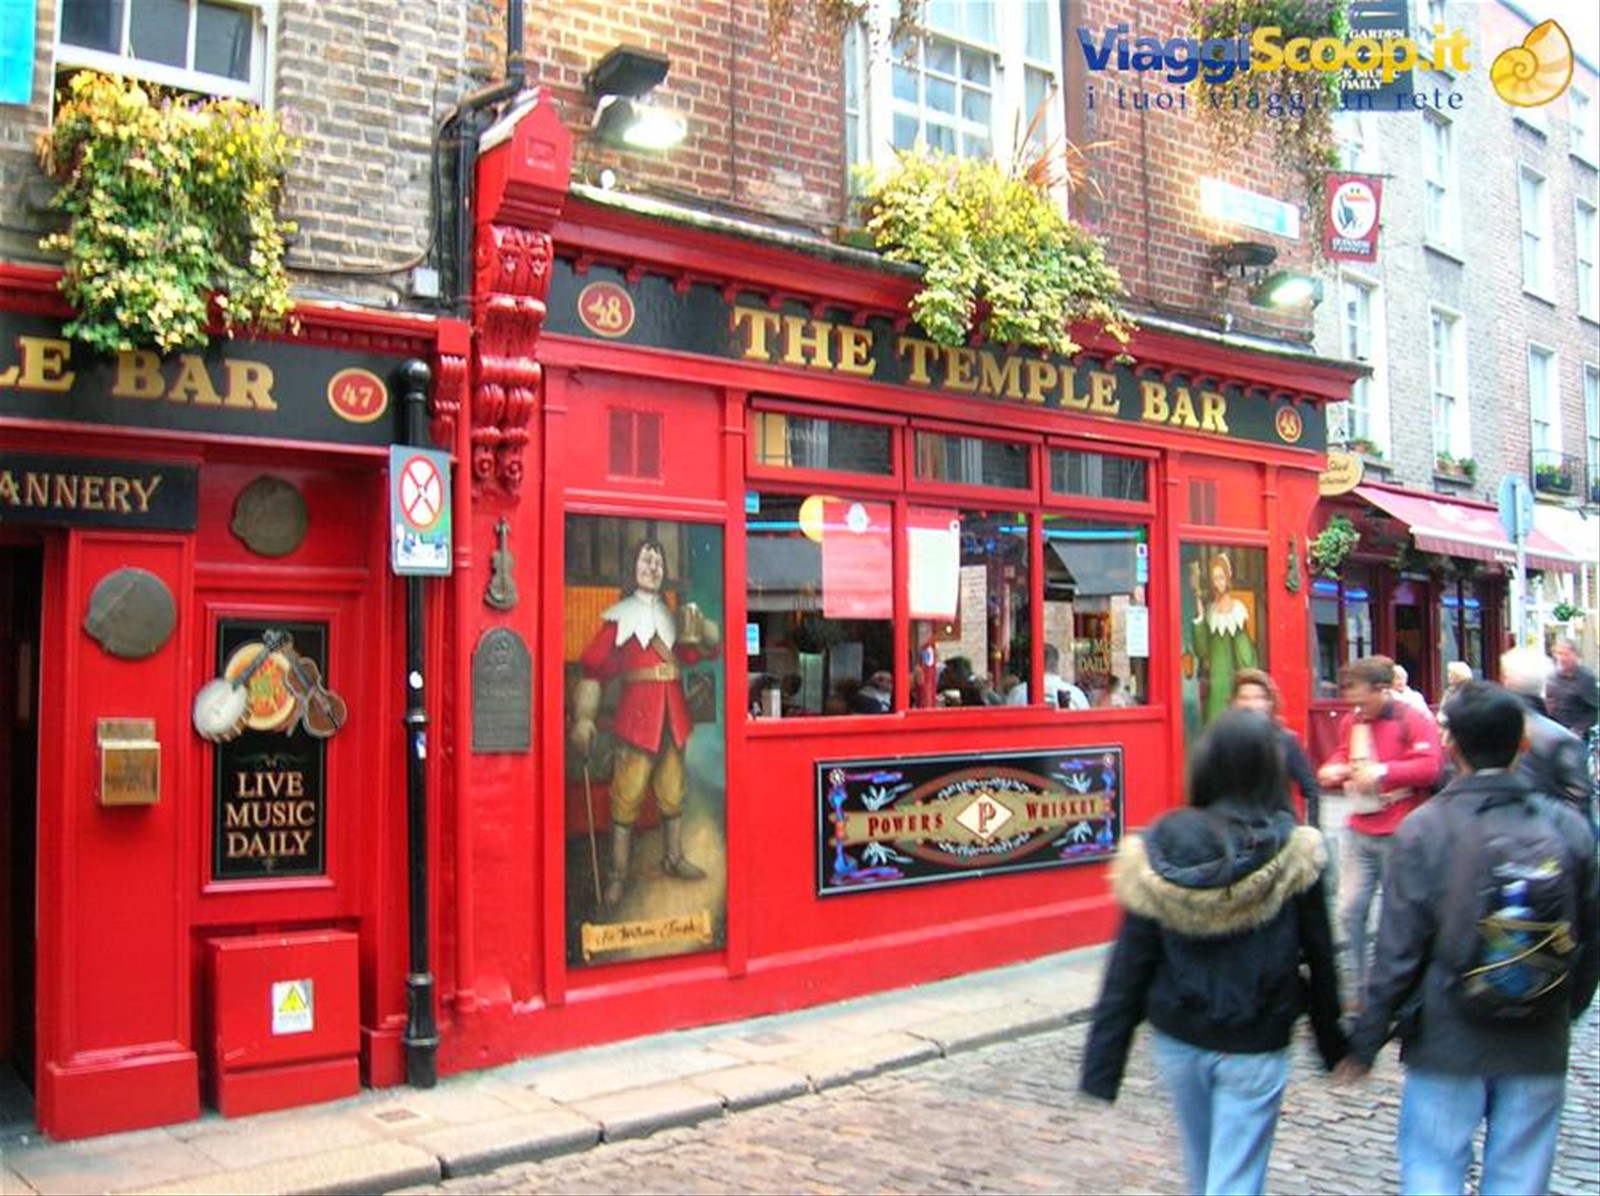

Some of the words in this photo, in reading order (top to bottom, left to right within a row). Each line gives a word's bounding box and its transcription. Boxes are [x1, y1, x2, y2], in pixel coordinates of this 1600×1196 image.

[587, 294, 624, 329] 48
[112, 348, 278, 410] BAR
[733, 305, 876, 377] THE
[900, 337, 1121, 416] TEMPLE
[1139, 380, 1229, 434] BAR
[341, 383, 376, 408] 47
[236, 771, 304, 798] LIVE
[225, 801, 316, 827] MUSIC
[868, 812, 945, 837] POWERS
[978, 801, 997, 833] P
[1025, 799, 1096, 821] WHISKEY
[226, 831, 312, 858] DAILY
